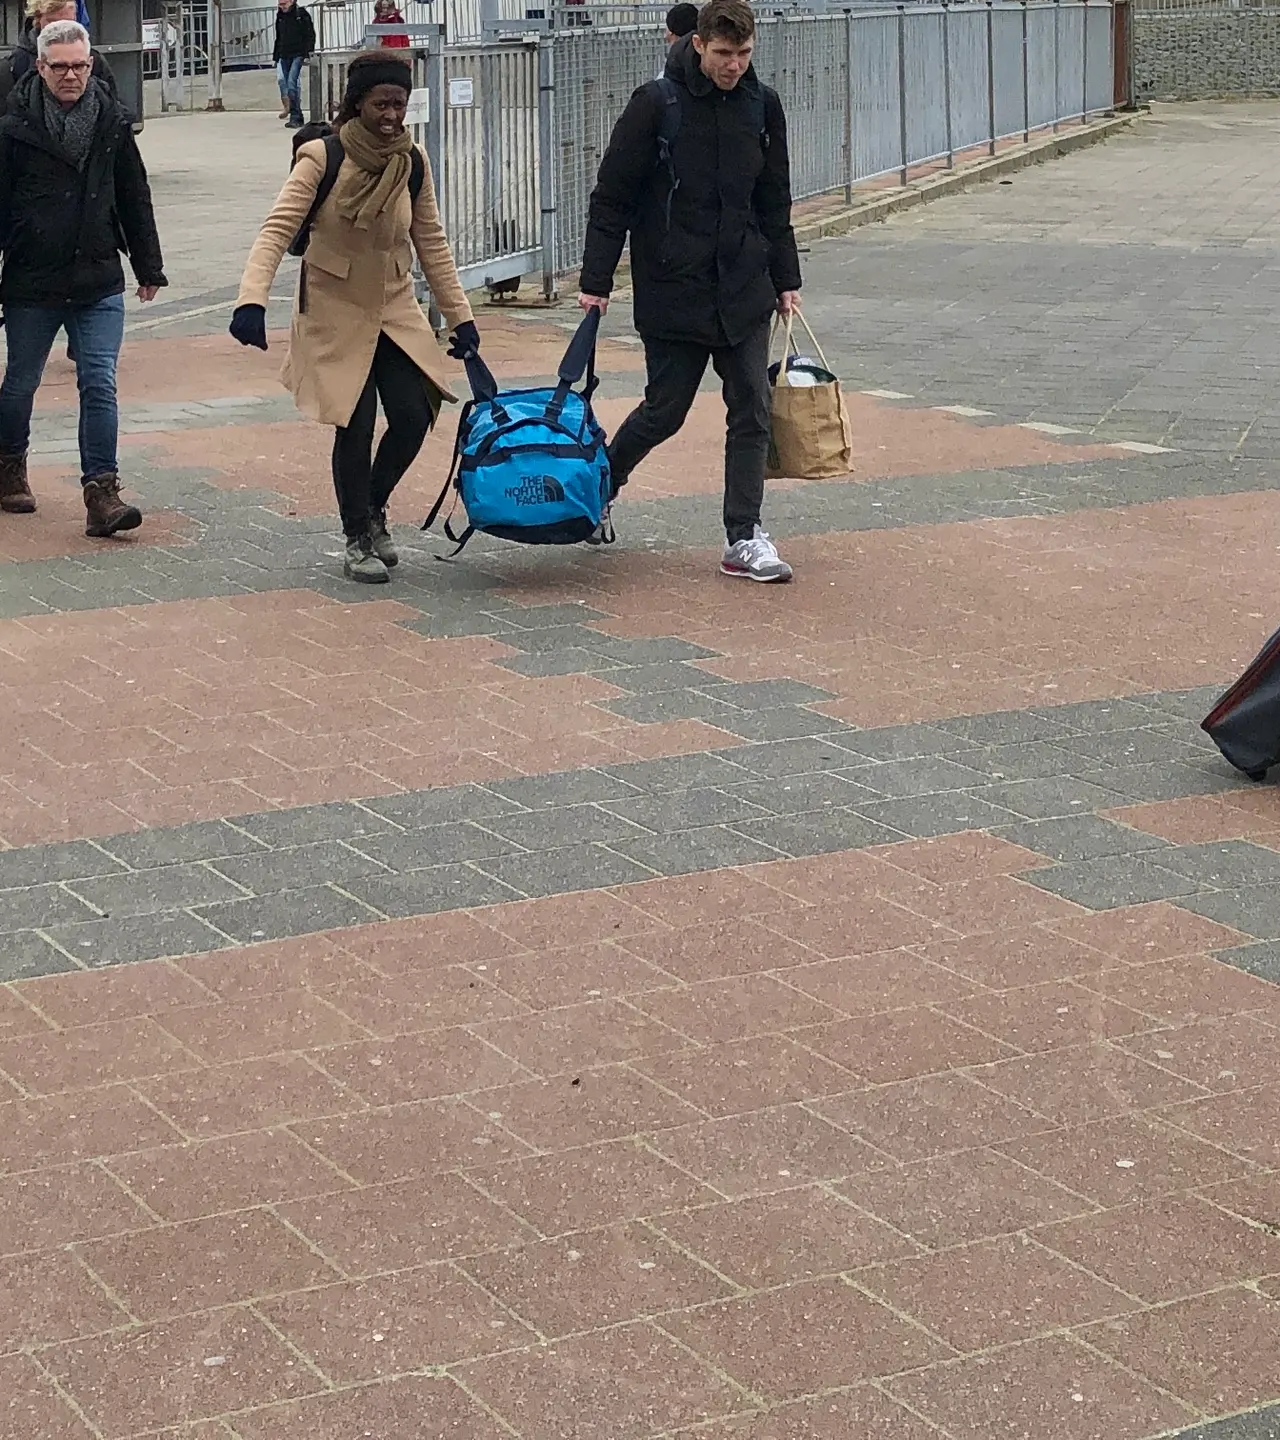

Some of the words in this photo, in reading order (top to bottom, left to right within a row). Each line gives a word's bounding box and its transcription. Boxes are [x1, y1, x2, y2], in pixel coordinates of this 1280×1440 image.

[520, 475, 543, 486] THE
[504, 485, 544, 498] NORTH
[516, 494, 544, 507] FACE
[739, 549, 752, 563] N
